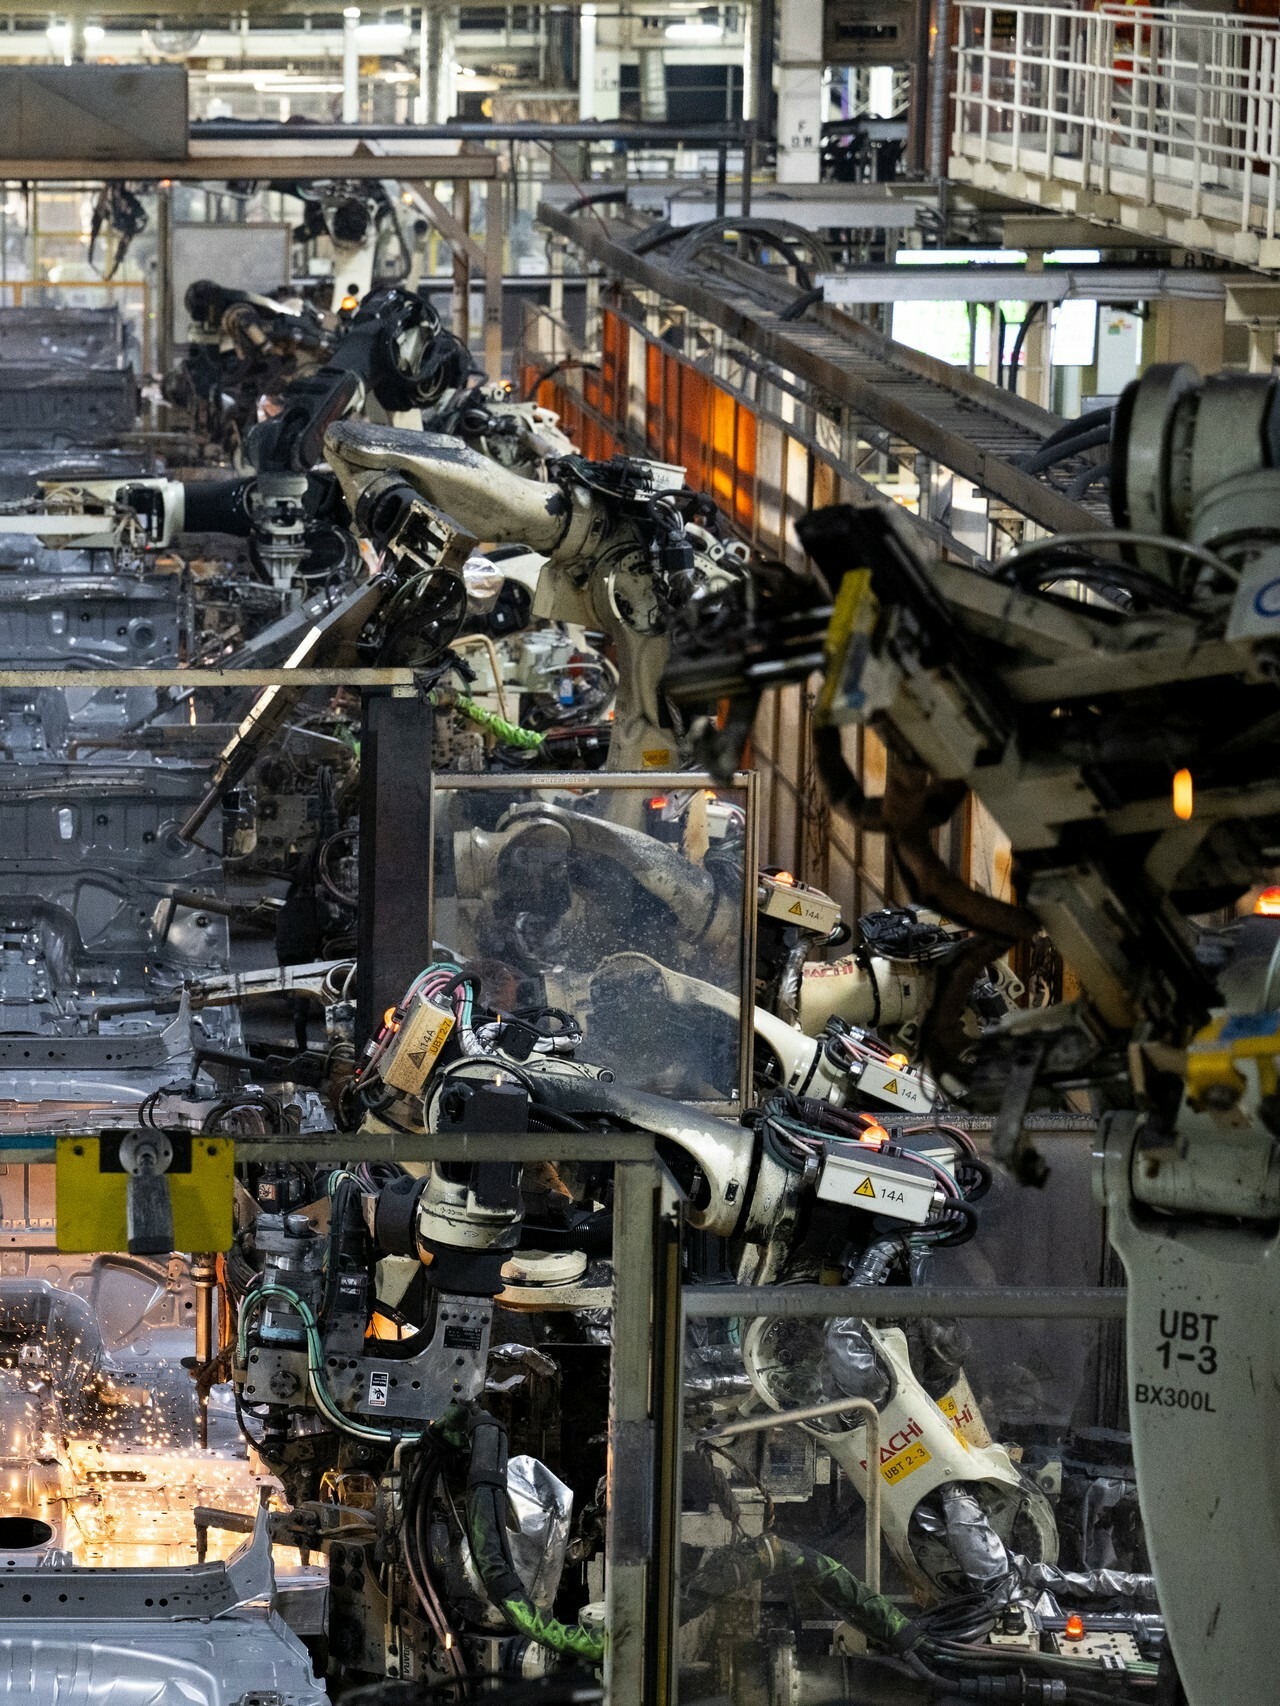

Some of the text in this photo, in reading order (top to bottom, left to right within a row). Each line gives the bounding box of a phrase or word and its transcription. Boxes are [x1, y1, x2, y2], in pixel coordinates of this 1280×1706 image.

[805, 909, 820, 920] 14A
[430, 1020, 451, 1053] UBT 2-7
[901, 1088, 918, 1101] 14A
[881, 1188, 904, 1203] 14A
[1159, 1308, 1219, 1344] UBT
[1156, 1340, 1218, 1375] 1-3
[1135, 1384, 1217, 1413] BX300L
[884, 1448, 926, 1480] UBT 2-3
